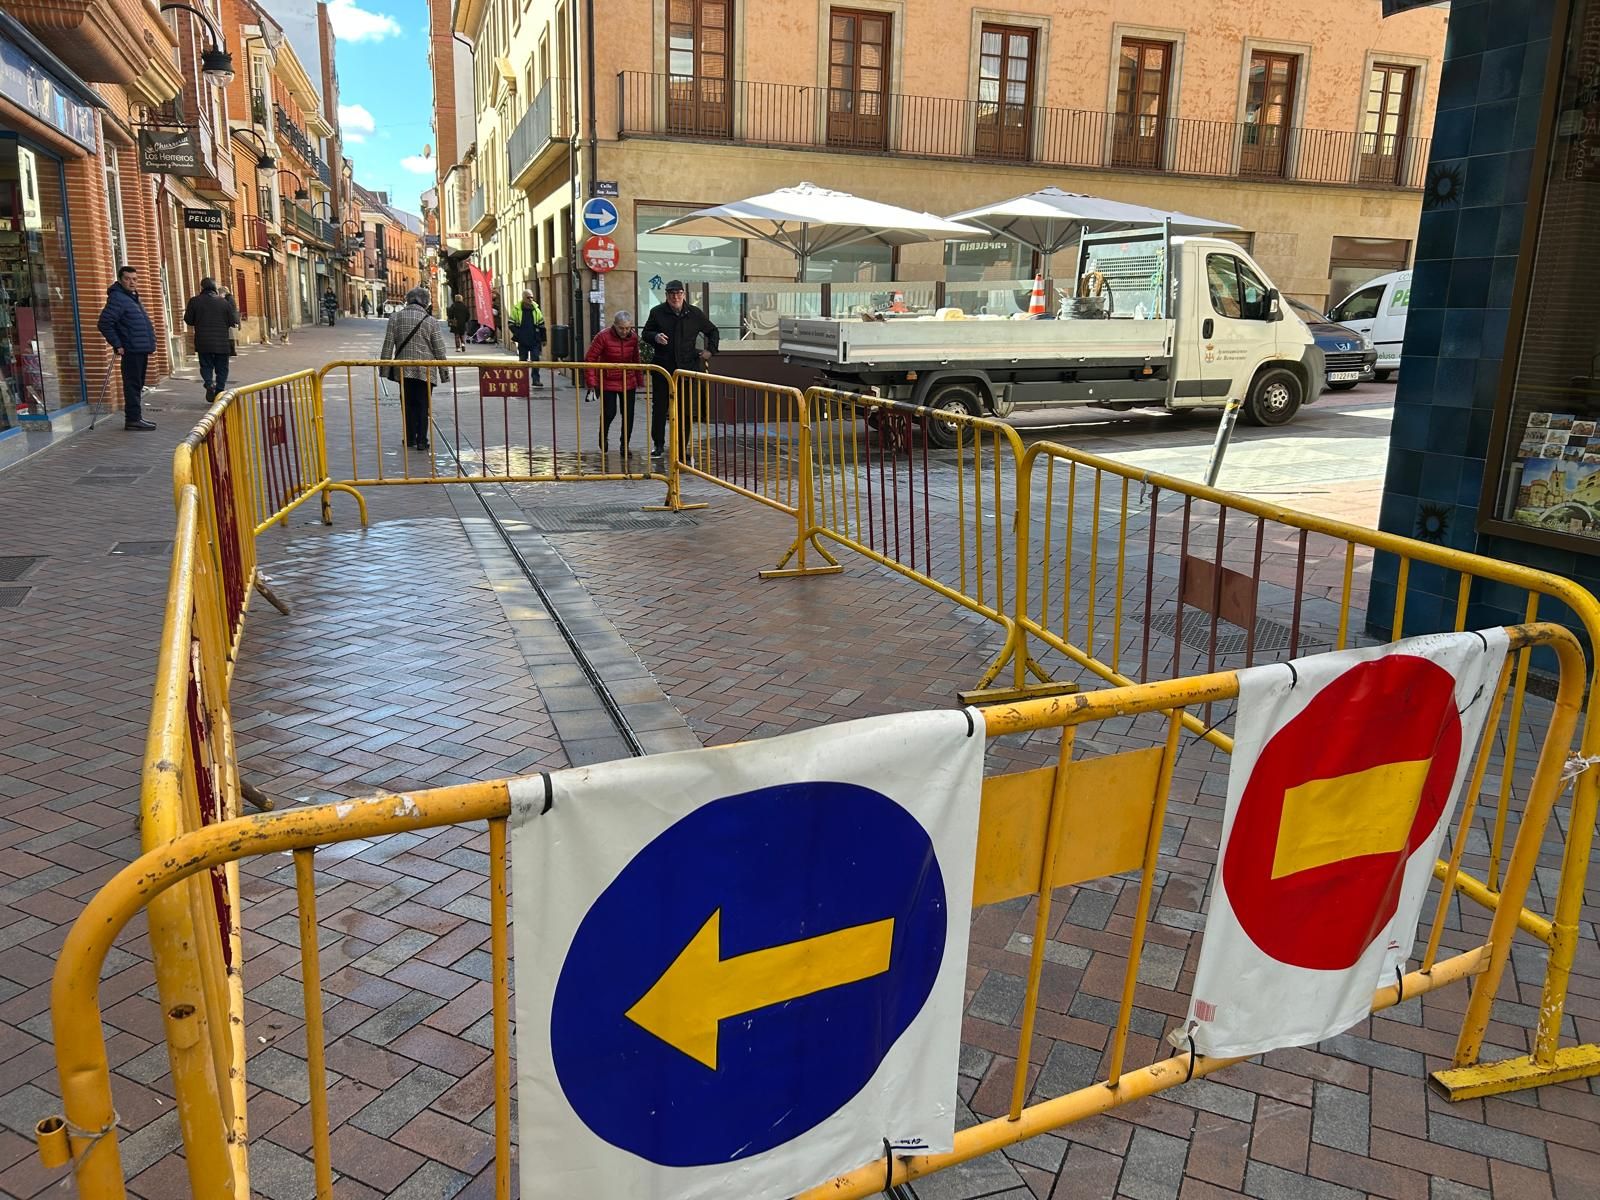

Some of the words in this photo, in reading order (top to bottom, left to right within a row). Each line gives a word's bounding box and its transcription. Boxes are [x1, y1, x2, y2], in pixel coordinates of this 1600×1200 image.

[145, 151, 158, 160] Los
[160, 153, 194, 162] Herreros
[189, 215, 221, 223] PELUSA
[482, 369, 524, 380] AYTO
[489, 382, 518, 393] BTE
